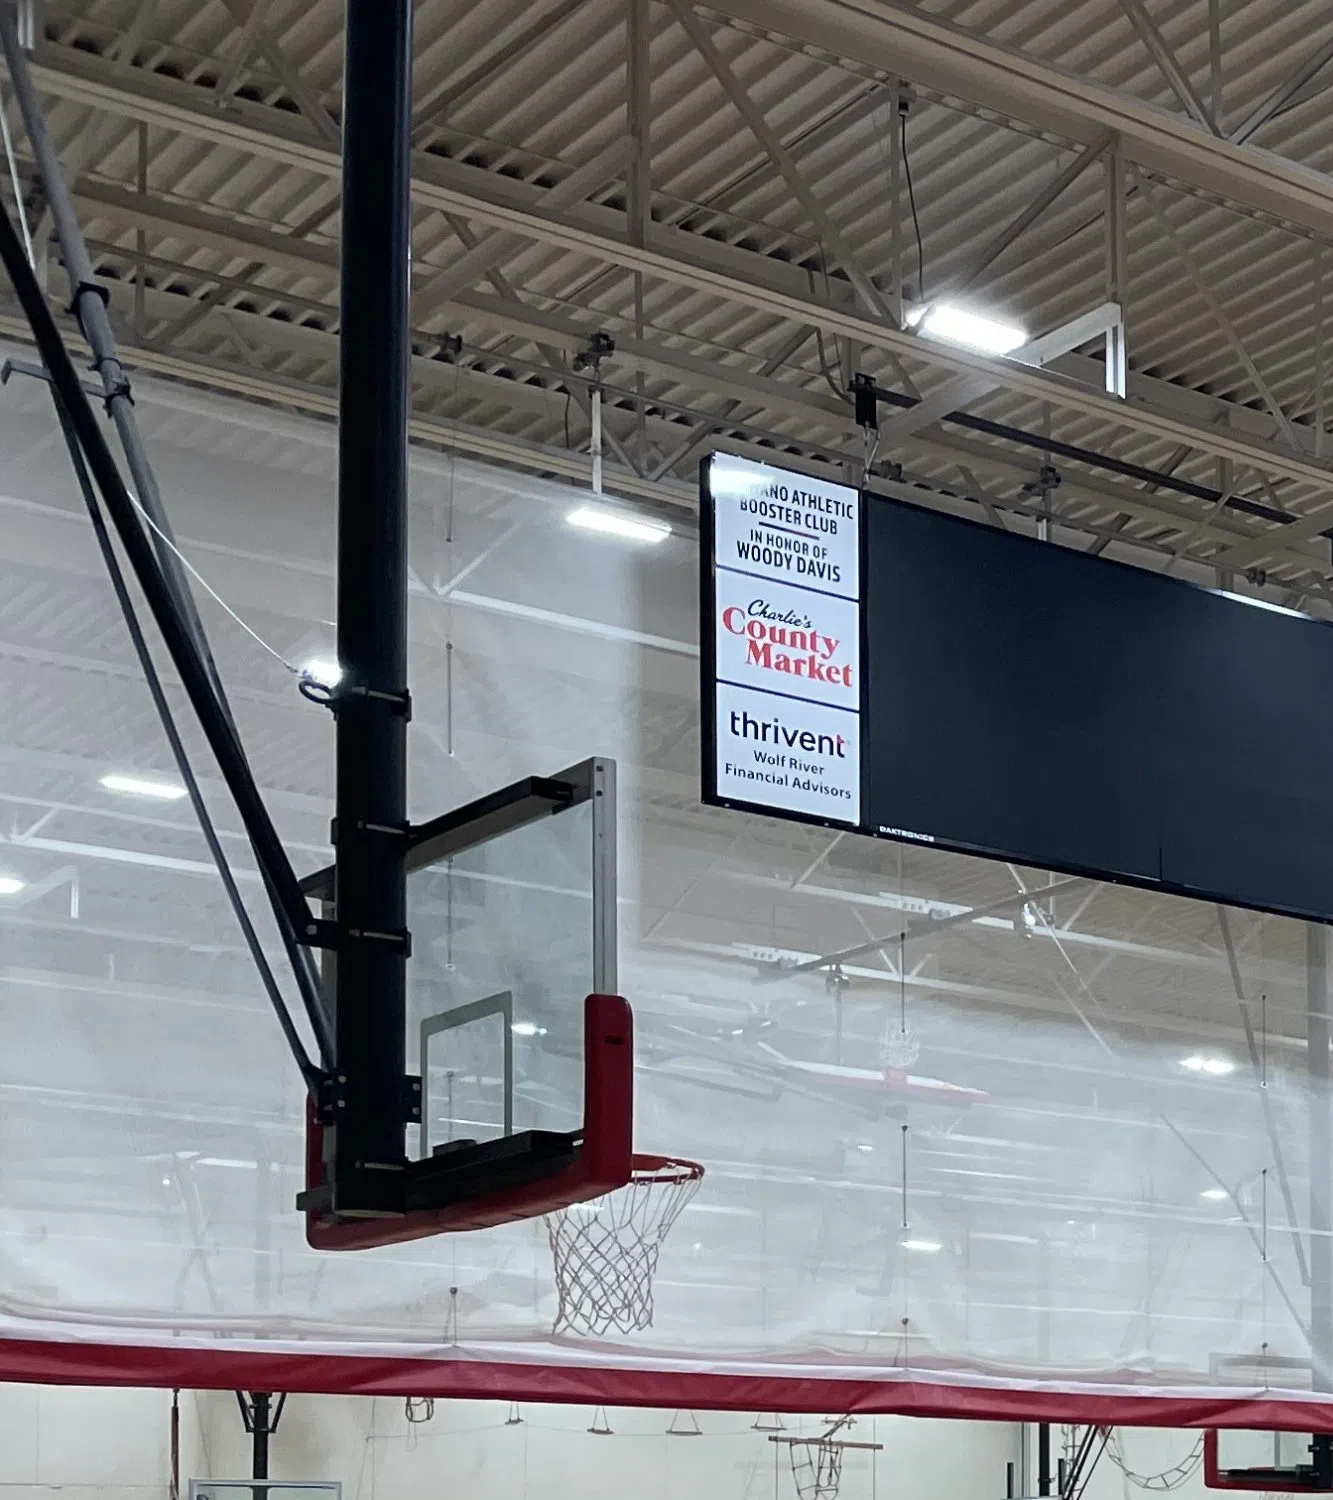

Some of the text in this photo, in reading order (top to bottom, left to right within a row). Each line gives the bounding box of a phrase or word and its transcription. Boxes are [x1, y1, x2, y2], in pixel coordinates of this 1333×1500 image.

[740, 496, 837, 535] BOOSTER CLUB
[792, 490, 853, 519] ATHLETIC
[737, 540, 841, 582] WOODY DAVIS
[750, 529, 828, 560] IN HONOR OF
[747, 599, 813, 628] Charlie's
[722, 606, 840, 660] County
[745, 638, 853, 687] Market
[730, 711, 845, 758] thrivent
[725, 762, 851, 799] Financial Advisors
[754, 750, 825, 775] Wolf River
